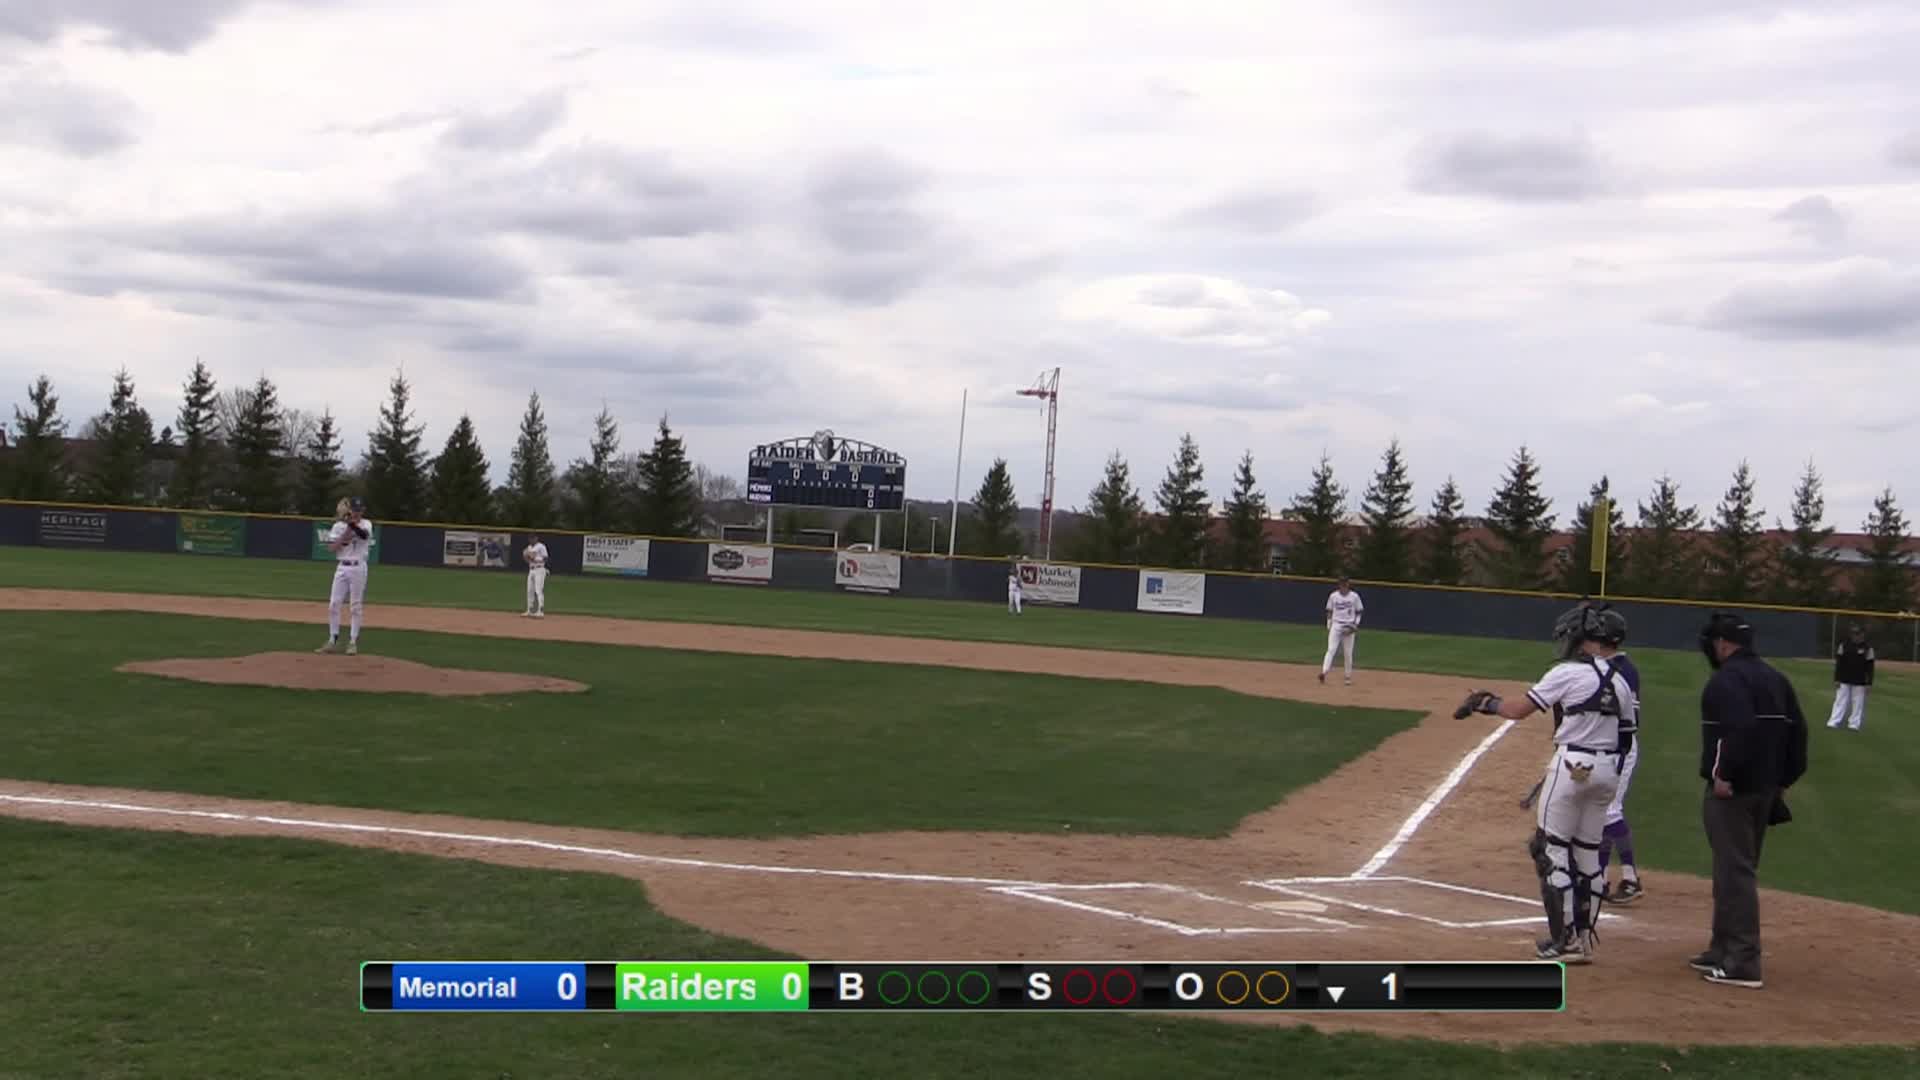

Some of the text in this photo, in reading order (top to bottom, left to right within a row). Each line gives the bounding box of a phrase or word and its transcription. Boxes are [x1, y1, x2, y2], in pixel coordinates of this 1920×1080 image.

[757, 445, 900, 464] RAIDER BASEBALL
[793, 469, 801, 480] 0
[822, 471, 830, 480] 0
[851, 472, 859, 482] 0
[867, 489, 875, 498] 0
[867, 499, 874, 508] 0
[40, 514, 108, 527] HERITAGE
[1039, 567, 1072, 577] Market
[1039, 576, 1077, 588] Johnson
